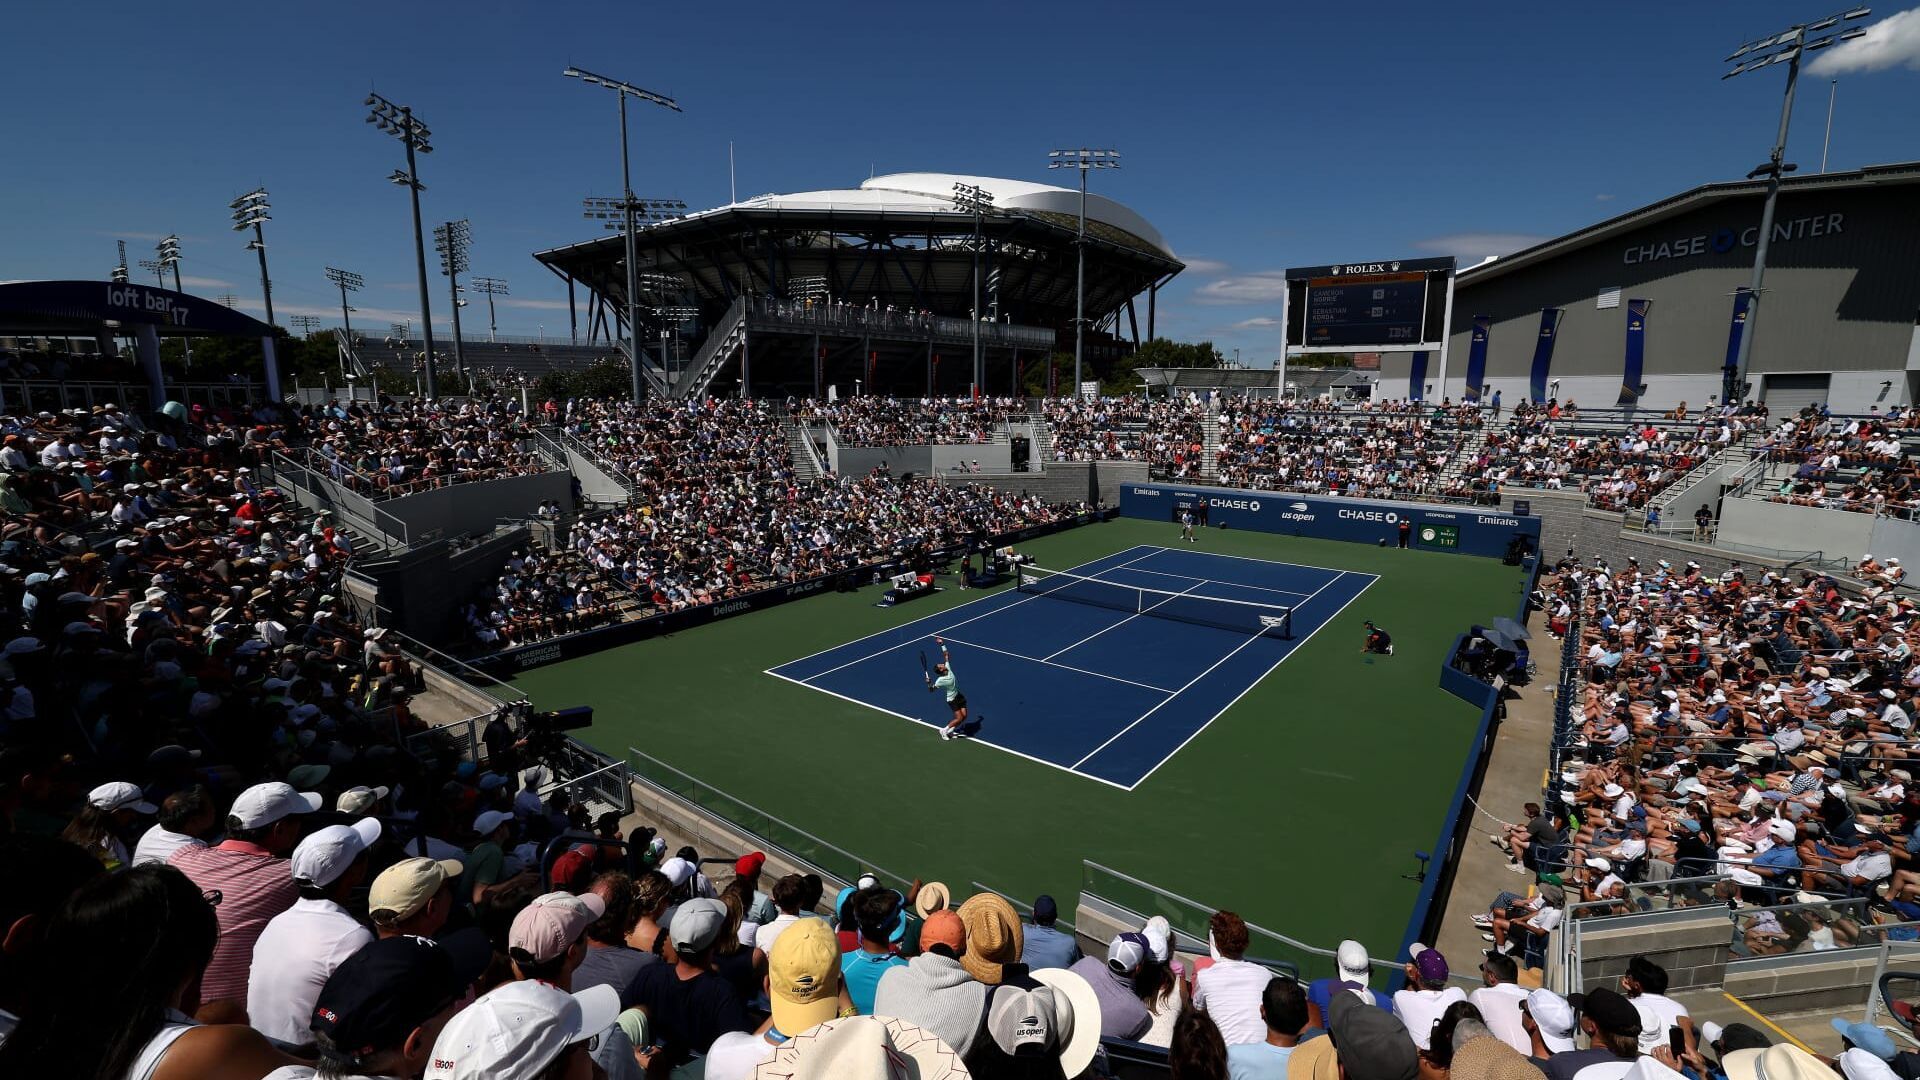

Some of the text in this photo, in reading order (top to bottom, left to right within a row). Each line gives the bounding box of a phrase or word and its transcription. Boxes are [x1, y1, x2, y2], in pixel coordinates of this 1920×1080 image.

[1623, 213, 1844, 264] CHASE CNTER
[1345, 263, 1385, 275] ROLEX
[107, 285, 173, 312] loft bar
[171, 306, 189, 326] 17
[1388, 327, 1413, 338] IBM
[1133, 487, 1160, 497] Emirates
[1210, 498, 1249, 510] CHASE
[1281, 511, 1315, 522] us open
[1338, 509, 1383, 522] CHASE
[1478, 515, 1519, 527] Emirates
[514, 644, 560, 662] AMERICAN
[522, 651, 561, 667] EXPRESS
[1025, 1028, 1044, 1037] open
